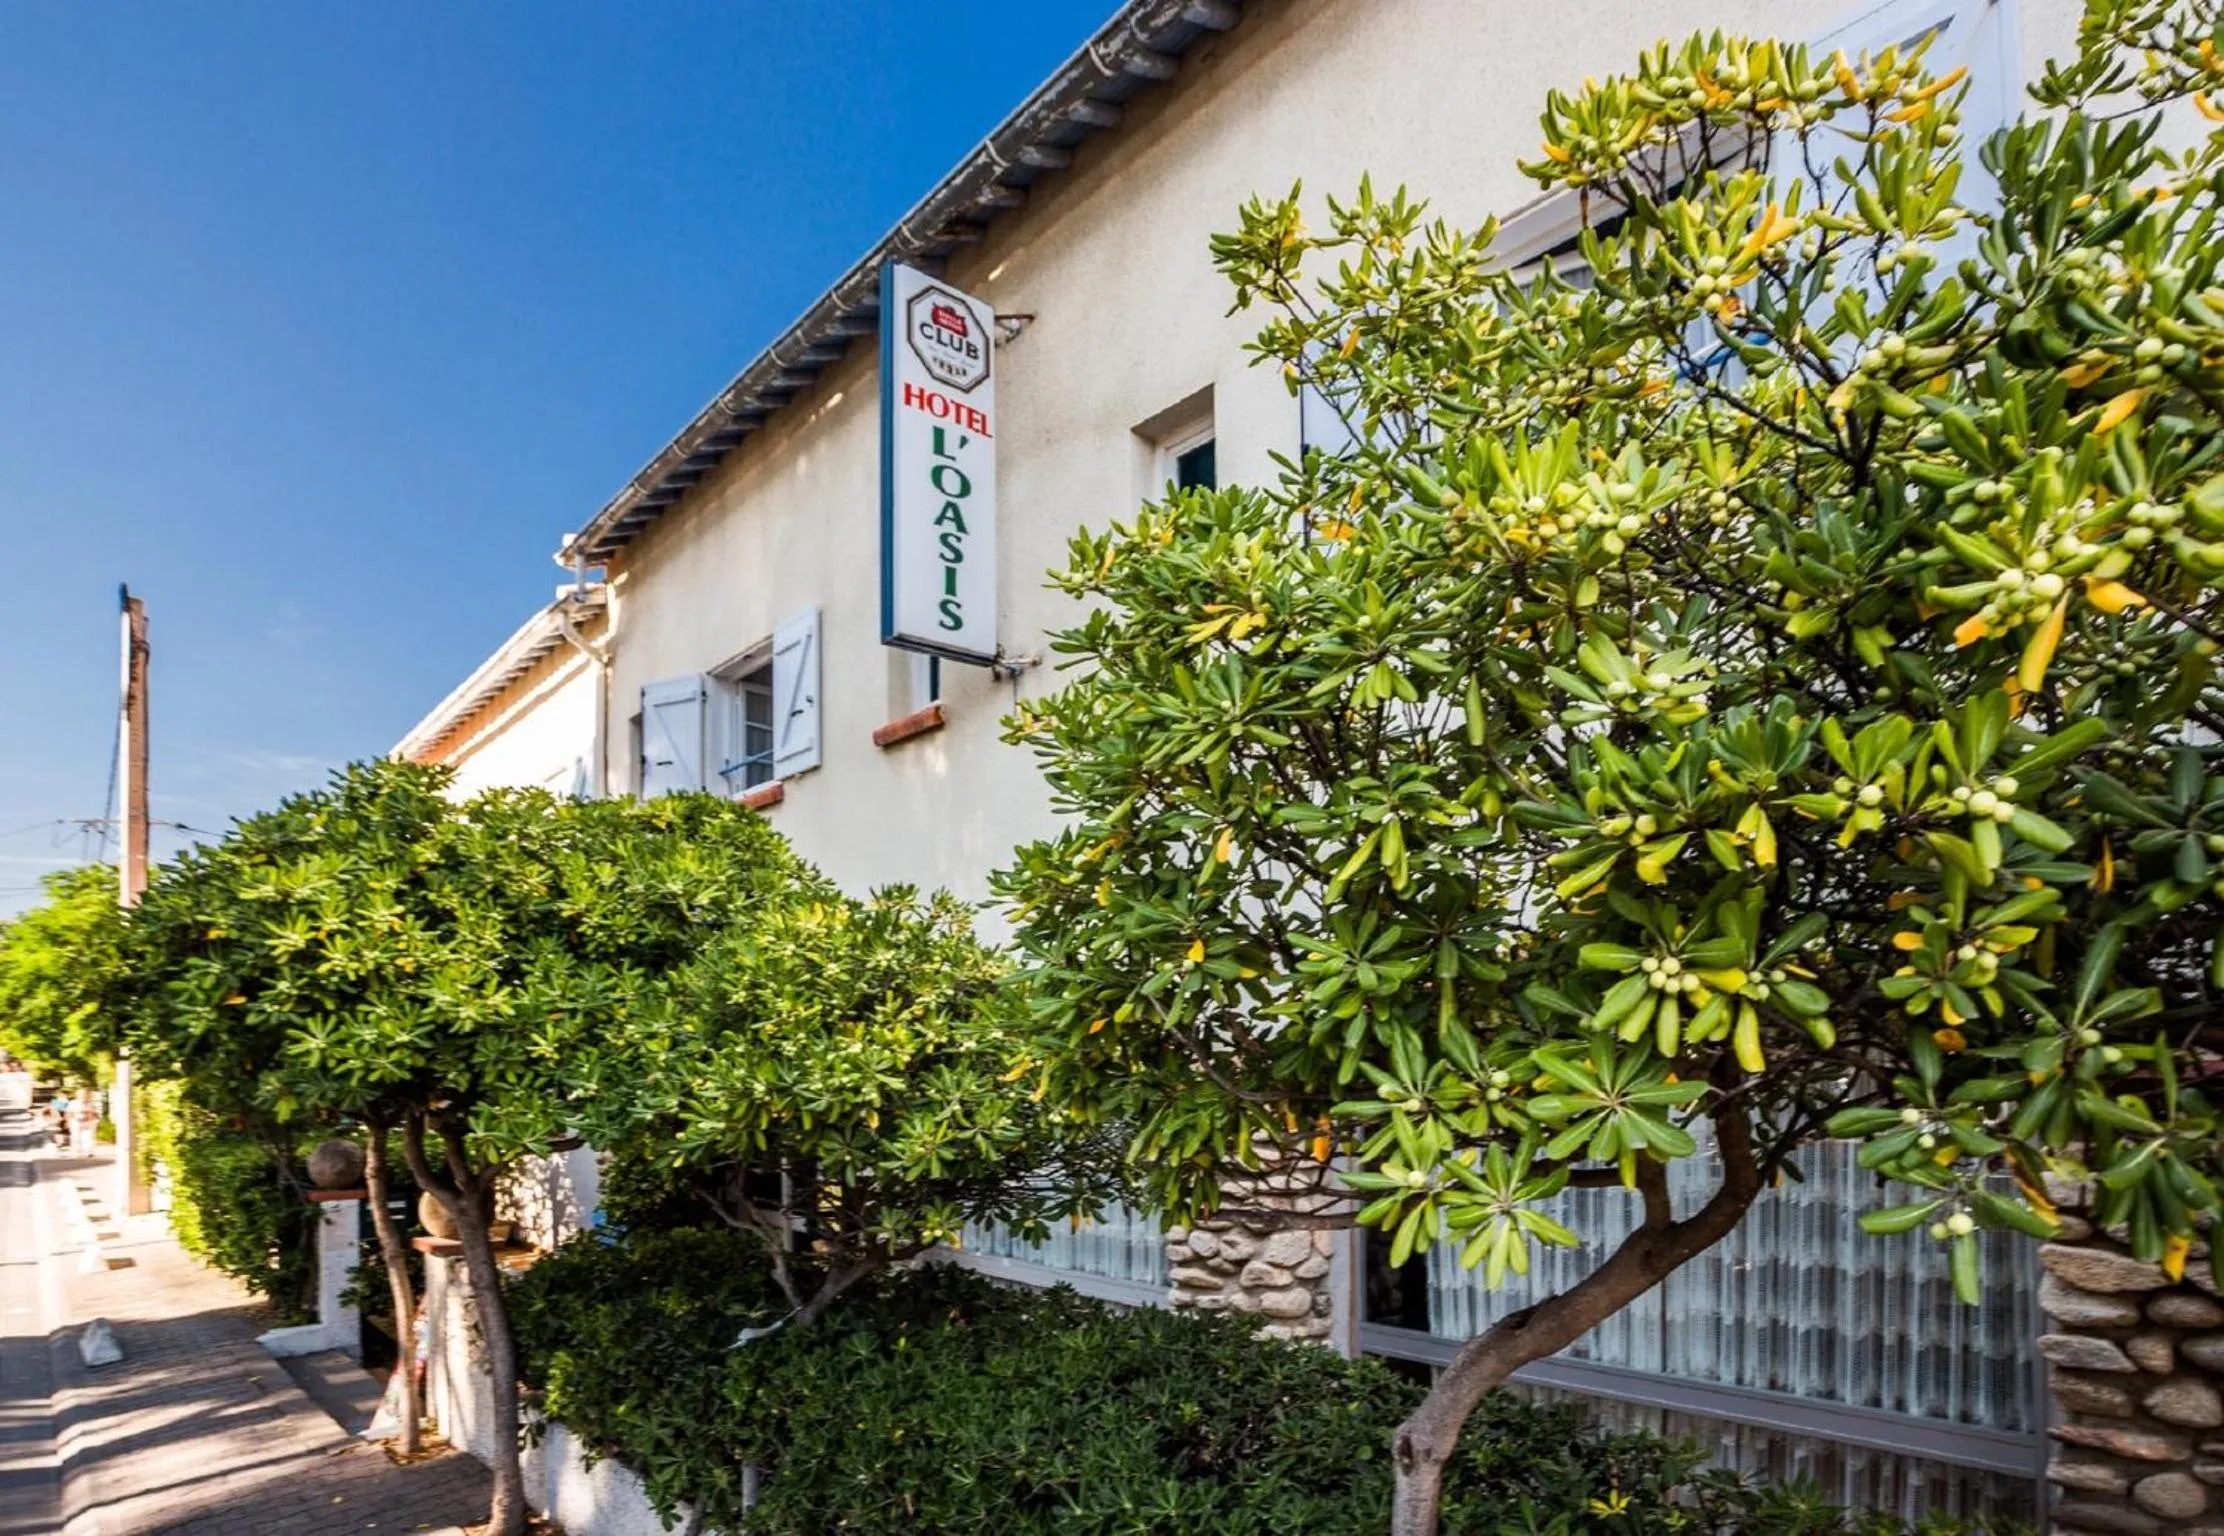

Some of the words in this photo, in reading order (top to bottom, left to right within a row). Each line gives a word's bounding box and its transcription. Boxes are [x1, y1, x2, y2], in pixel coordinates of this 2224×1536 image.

[920, 322, 979, 360] CLUB
[904, 382, 993, 438] HOTEL
[931, 425, 972, 631] L'OASIS
